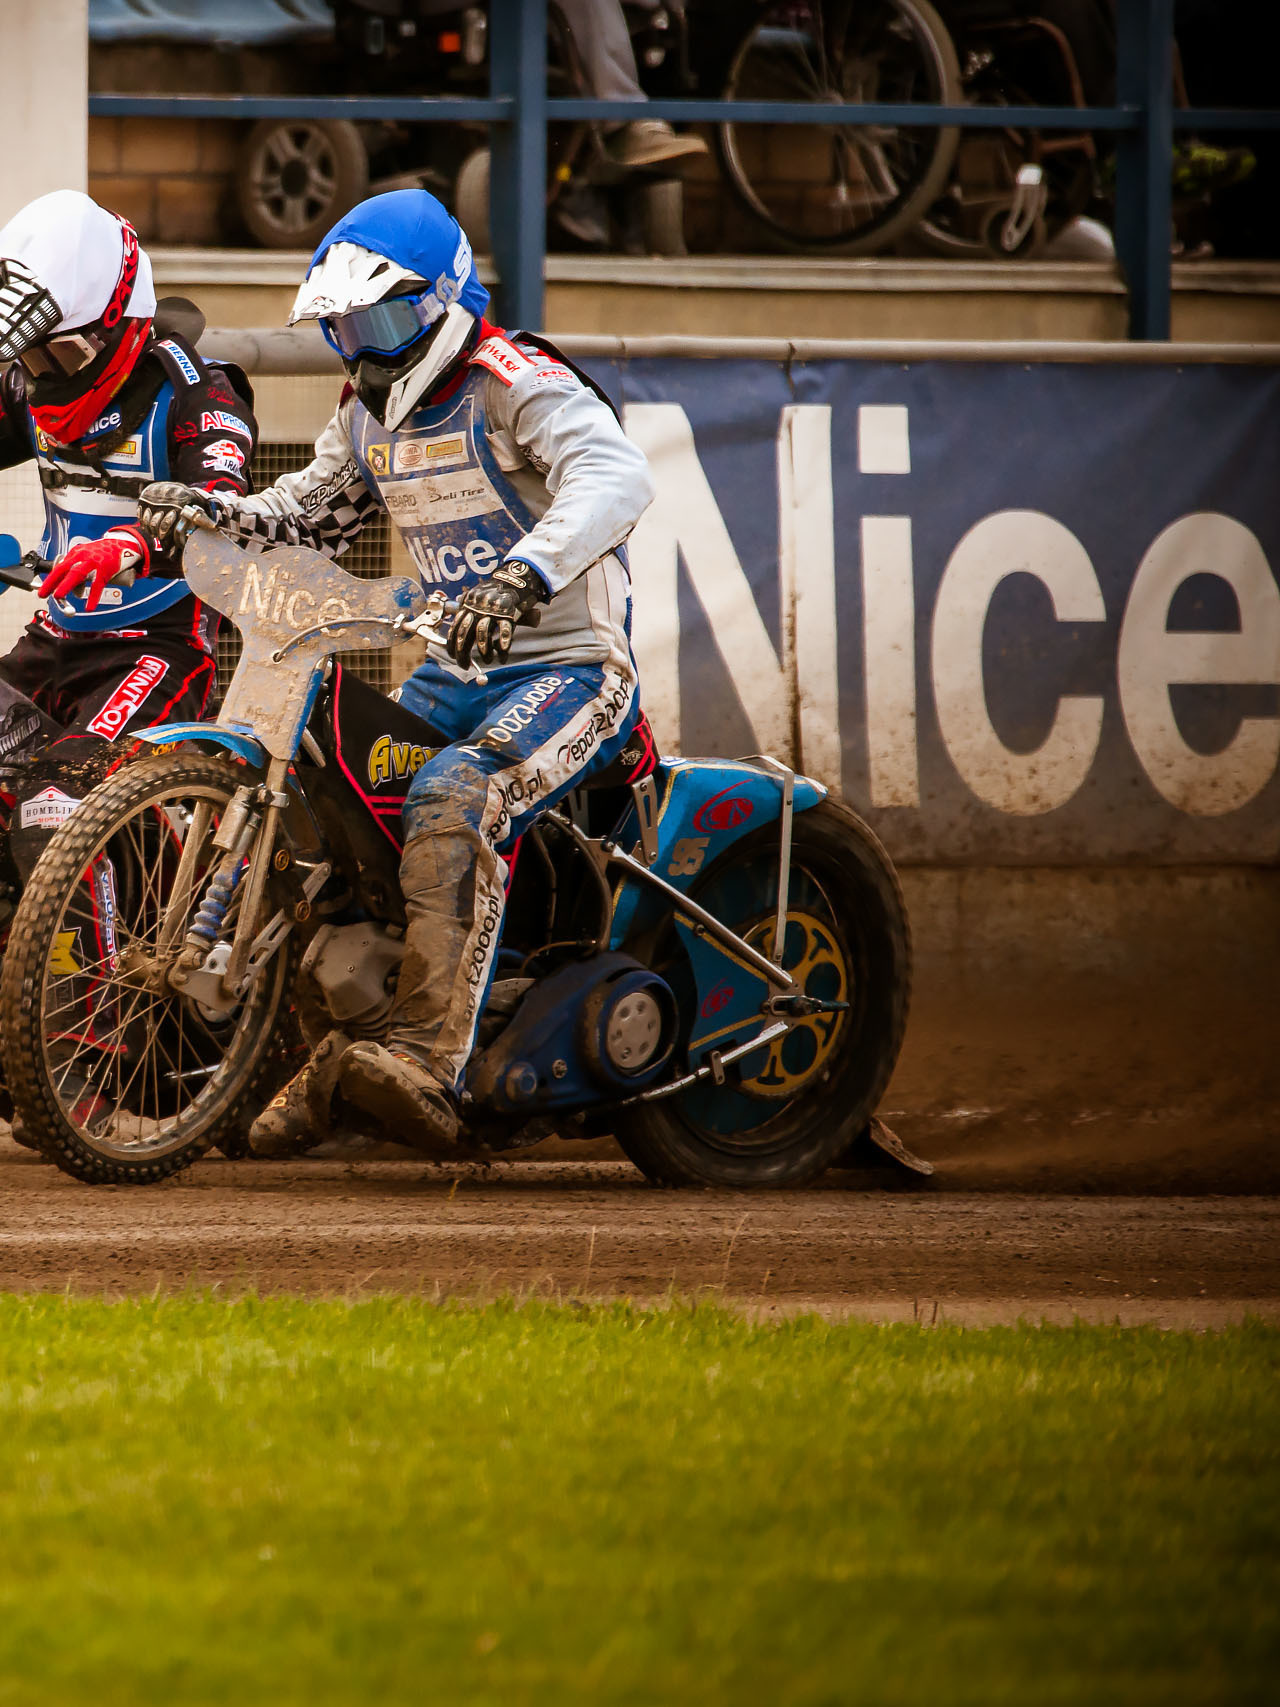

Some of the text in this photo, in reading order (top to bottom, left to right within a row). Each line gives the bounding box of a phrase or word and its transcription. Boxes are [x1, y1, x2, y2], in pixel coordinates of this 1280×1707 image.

[168, 346, 198, 383] BERNER
[459, 487, 485, 498] Tire
[404, 536, 499, 583] Nice
[239, 561, 353, 637] Nice
[623, 402, 1280, 816] Nice
[668, 837, 711, 876] 95
